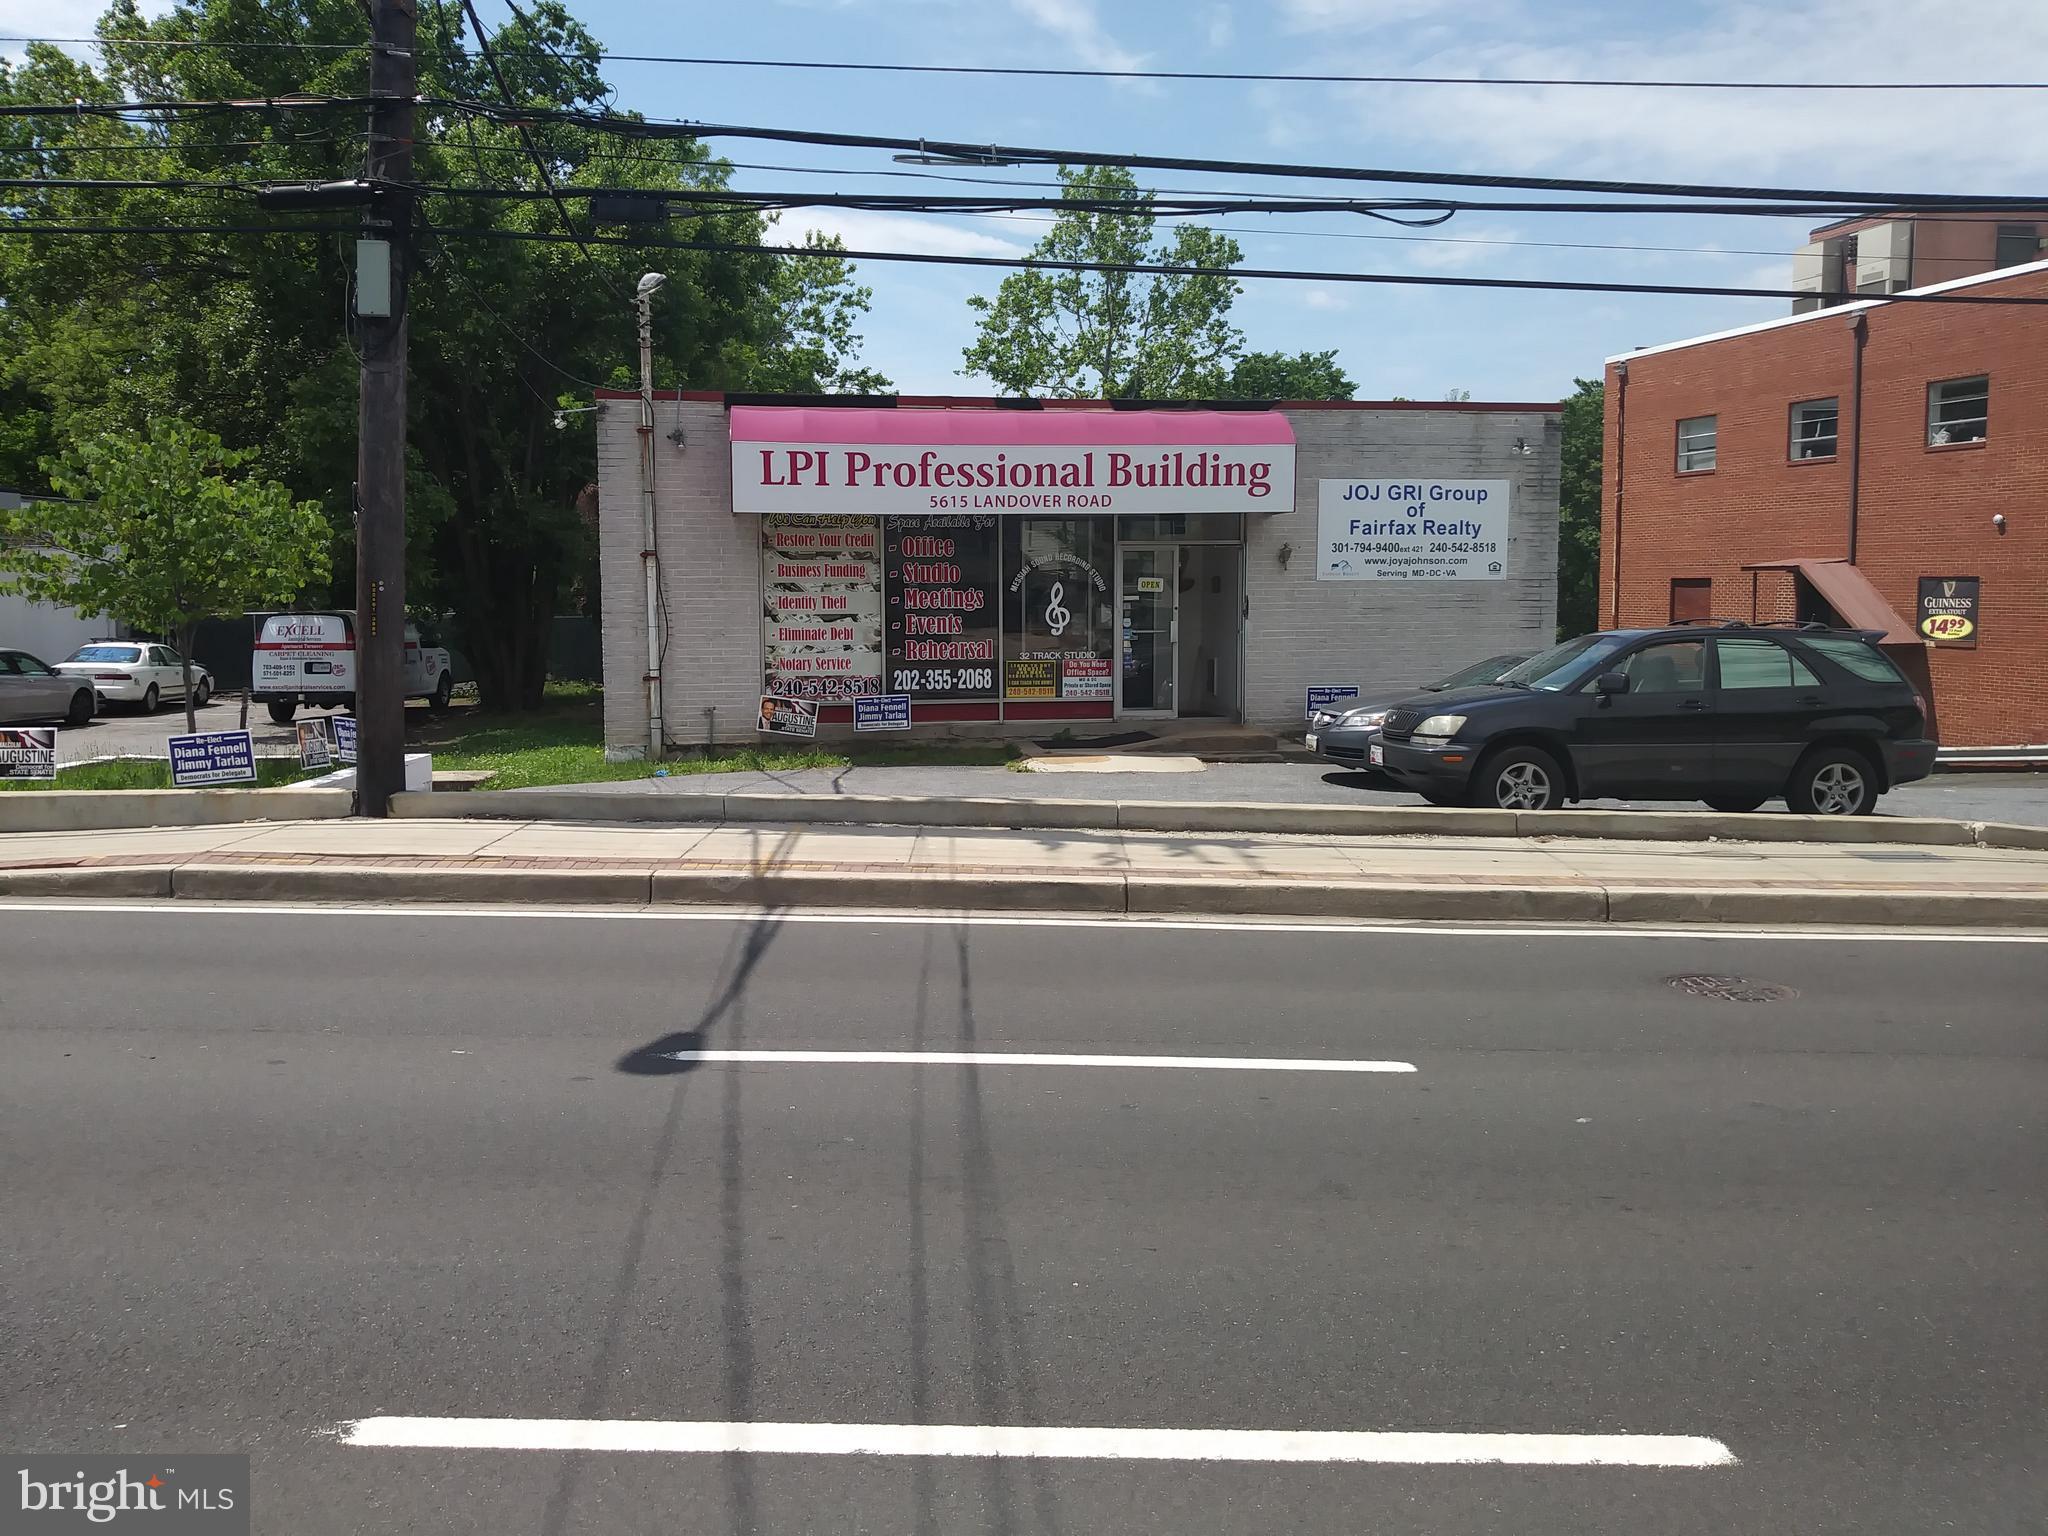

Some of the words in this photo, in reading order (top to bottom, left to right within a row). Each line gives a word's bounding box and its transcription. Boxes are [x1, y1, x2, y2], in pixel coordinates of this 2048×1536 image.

[759, 450, 830, 487] LPI
[844, 450, 1094, 488] Professional
[1106, 451, 1272, 497] Building
[930, 494, 968, 508] 5615
[974, 495, 1062, 508] LANDOVER
[1066, 495, 1112, 508] ROAD
[1343, 484, 1380, 501] JOJ
[1388, 484, 1422, 501] GRI
[1430, 484, 1488, 504] Group
[1406, 502, 1425, 518] of
[769, 514, 793, 526] We
[794, 514, 816, 526] Can
[817, 514, 850, 528] Help
[850, 514, 874, 528] You
[886, 516, 921, 532] Space
[923, 516, 970, 528] Available
[974, 516, 995, 530] For
[1350, 520, 1416, 535] Fairfax
[1422, 520, 1482, 539] Realty
[776, 532, 815, 547] Restore
[817, 532, 842, 546] Your
[844, 532, 874, 547] Credit
[902, 536, 955, 558] Office
[1332, 542, 1400, 553] 301-794-9400
[1430, 542, 1496, 553] 240-542-8518
[1364, 556, 1468, 566] www.joyajohnson.com
[778, 563, 822, 578] Business
[824, 564, 866, 580] Funding
[902, 562, 961, 584] Studio
[1010, 565, 1032, 592] MESSIAH
[1030, 554, 1052, 568] SOUND
[1055, 553, 1091, 571] RECORDING
[1089, 568, 1106, 592] STUDIO
[1376, 570, 1407, 578] Serving
[778, 596, 818, 611] Identity
[820, 596, 847, 609] Theft
[904, 588, 984, 610] Meetings
[1924, 597, 1972, 608] GUINNESS
[277, 624, 325, 637] EXCELL
[905, 614, 962, 634] Events
[779, 628, 828, 640] Eliminate
[830, 628, 854, 640] Debt
[905, 638, 994, 660] Rehearsal
[1019, 652, 1030, 660] 32
[1032, 652, 1061, 660] TRACK
[1064, 651, 1096, 659] STUDIO
[778, 658, 812, 673] Notary
[815, 658, 852, 670] Service
[894, 668, 992, 690] 202-355-2068
[773, 678, 880, 696] 240-542-8518
[858, 704, 879, 712] Diana
[881, 703, 906, 711] Fennell
[772, 712, 815, 726] AUGUSTINE
[858, 712, 883, 721] Jimmy
[196, 736, 222, 744] Re-Elect
[174, 747, 205, 758] Diana
[208, 742, 247, 755] Fennell
[176, 759, 212, 771] Jimmy
[214, 756, 248, 767] Tarlau
[221, 770, 246, 778] Delegate
